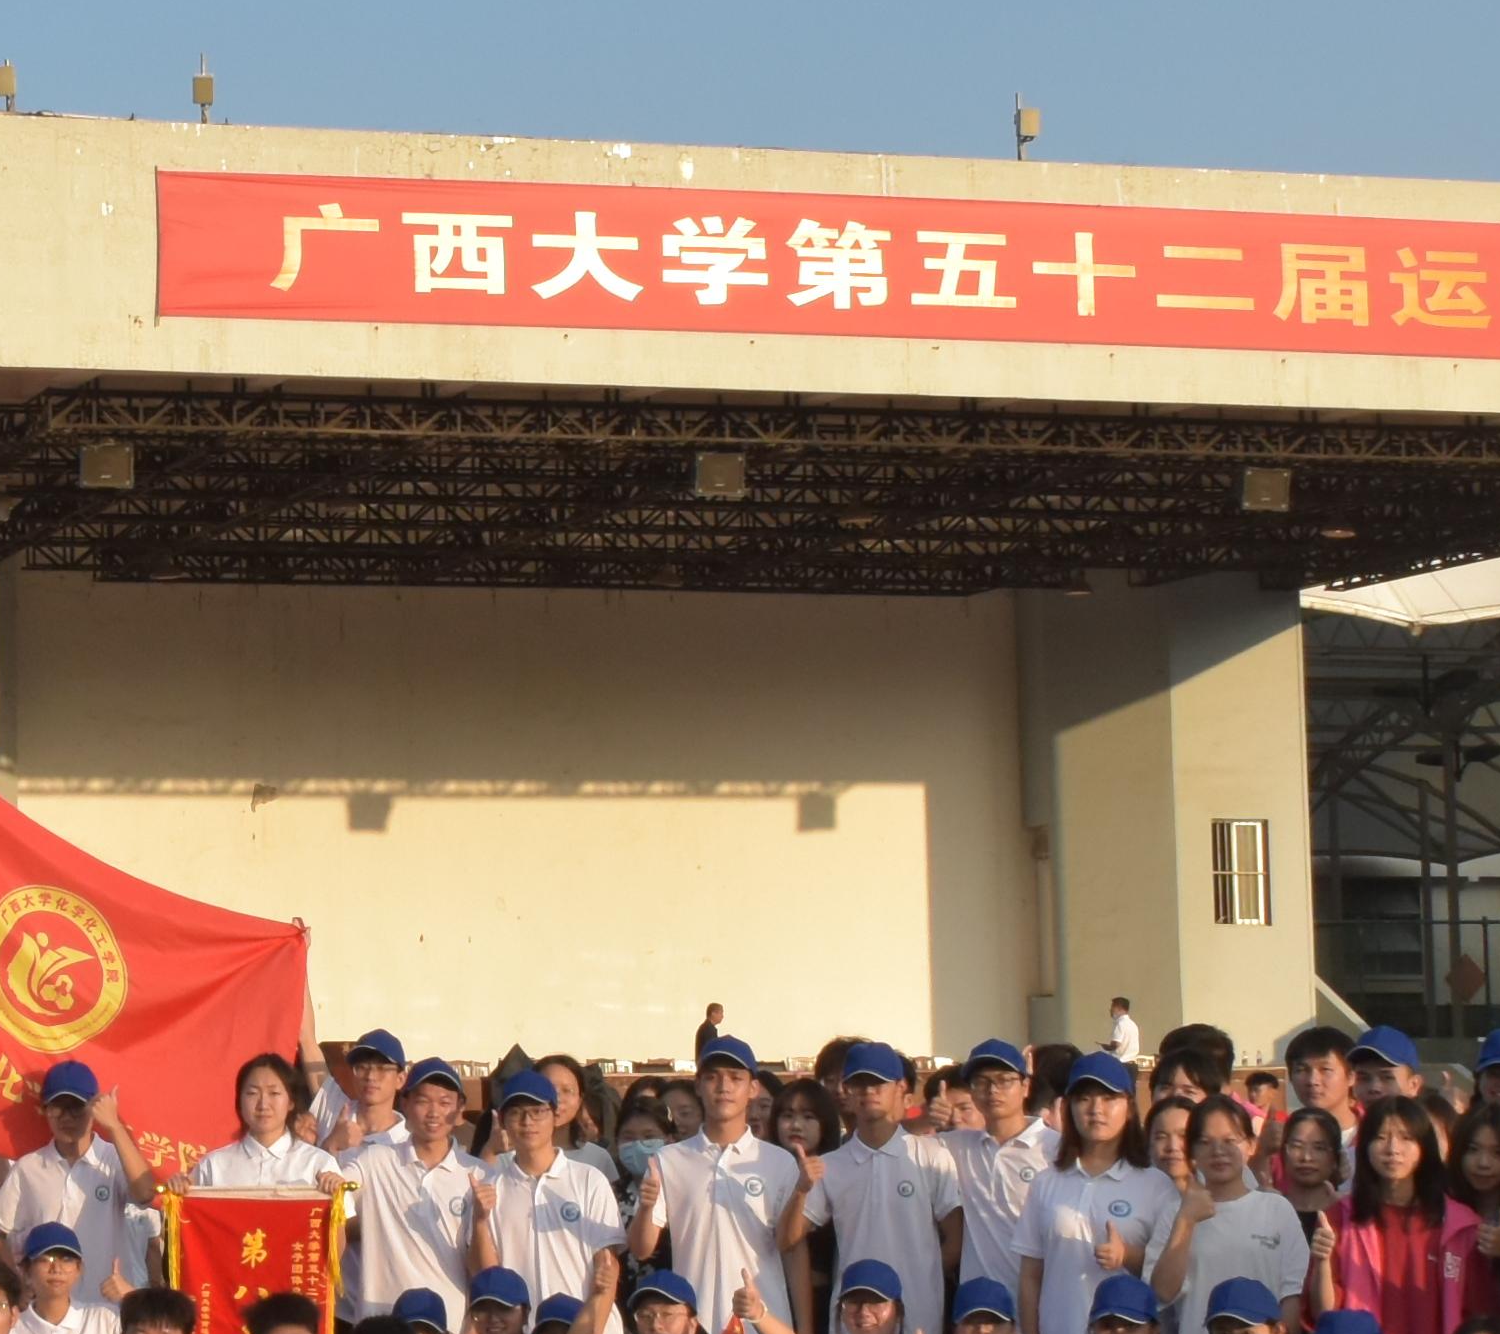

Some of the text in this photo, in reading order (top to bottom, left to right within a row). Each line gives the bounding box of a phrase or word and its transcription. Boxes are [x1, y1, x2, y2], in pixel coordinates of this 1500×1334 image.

[1, 893, 120, 983] 广西大学化学化工学院
[306, 1207, 323, 1303] 广西大学第五十二
